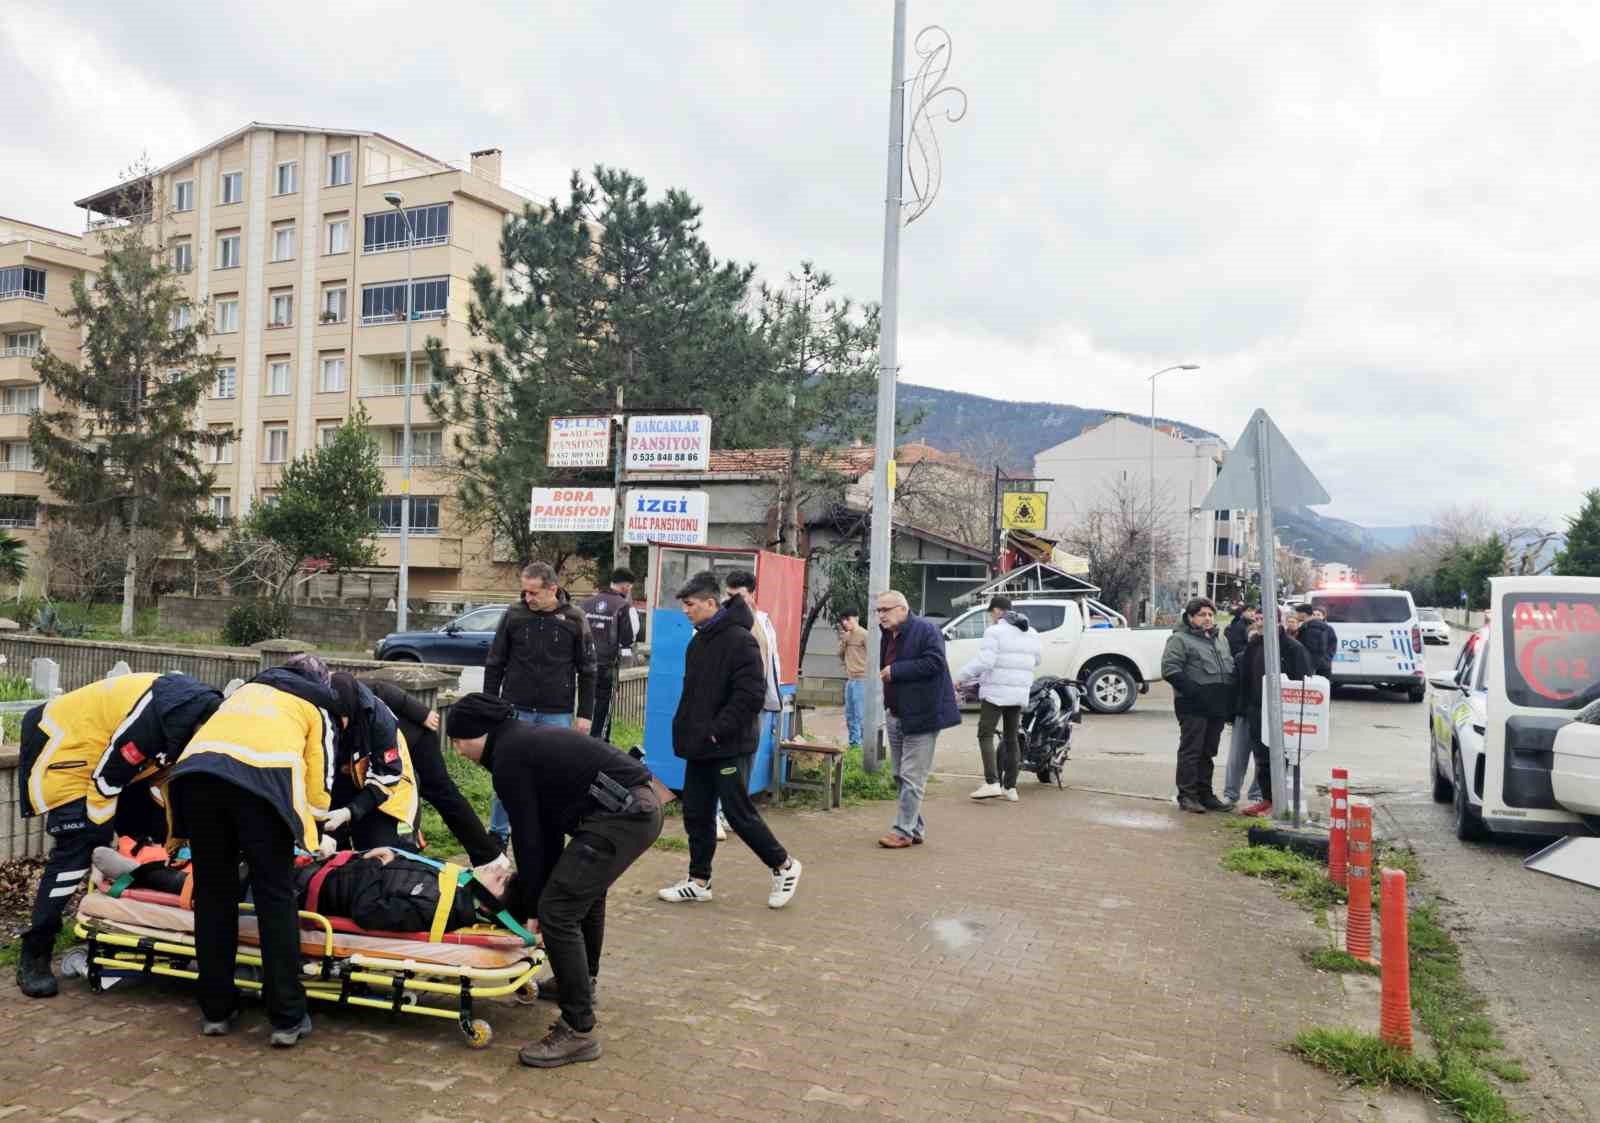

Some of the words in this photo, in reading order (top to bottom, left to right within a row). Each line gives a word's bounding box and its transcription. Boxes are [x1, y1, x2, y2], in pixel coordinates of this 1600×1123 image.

[632, 453, 638, 461] 0
[553, 491, 593, 502] BORA
[637, 495, 688, 513] İZGİ
